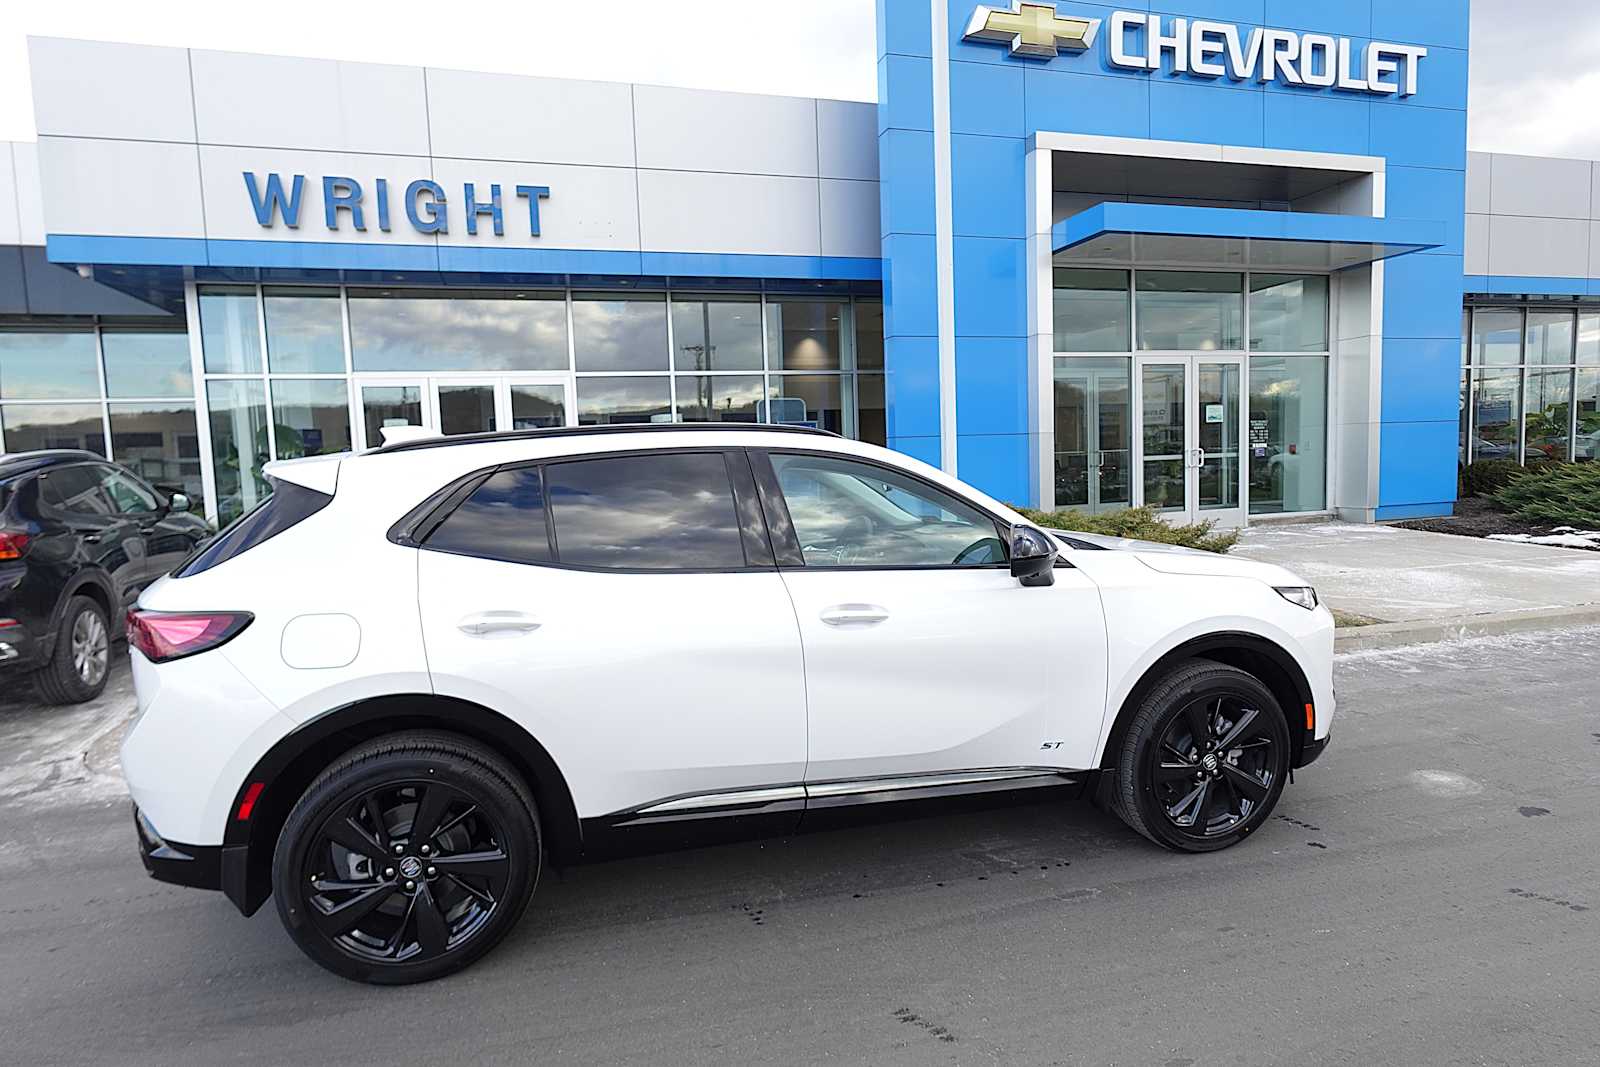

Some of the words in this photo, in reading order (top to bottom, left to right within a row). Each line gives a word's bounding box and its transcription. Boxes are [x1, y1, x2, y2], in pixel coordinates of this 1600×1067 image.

[1107, 10, 1428, 98] CHEVROLET
[242, 171, 551, 237] WRIGHT
[1040, 741, 1065, 750] ST
